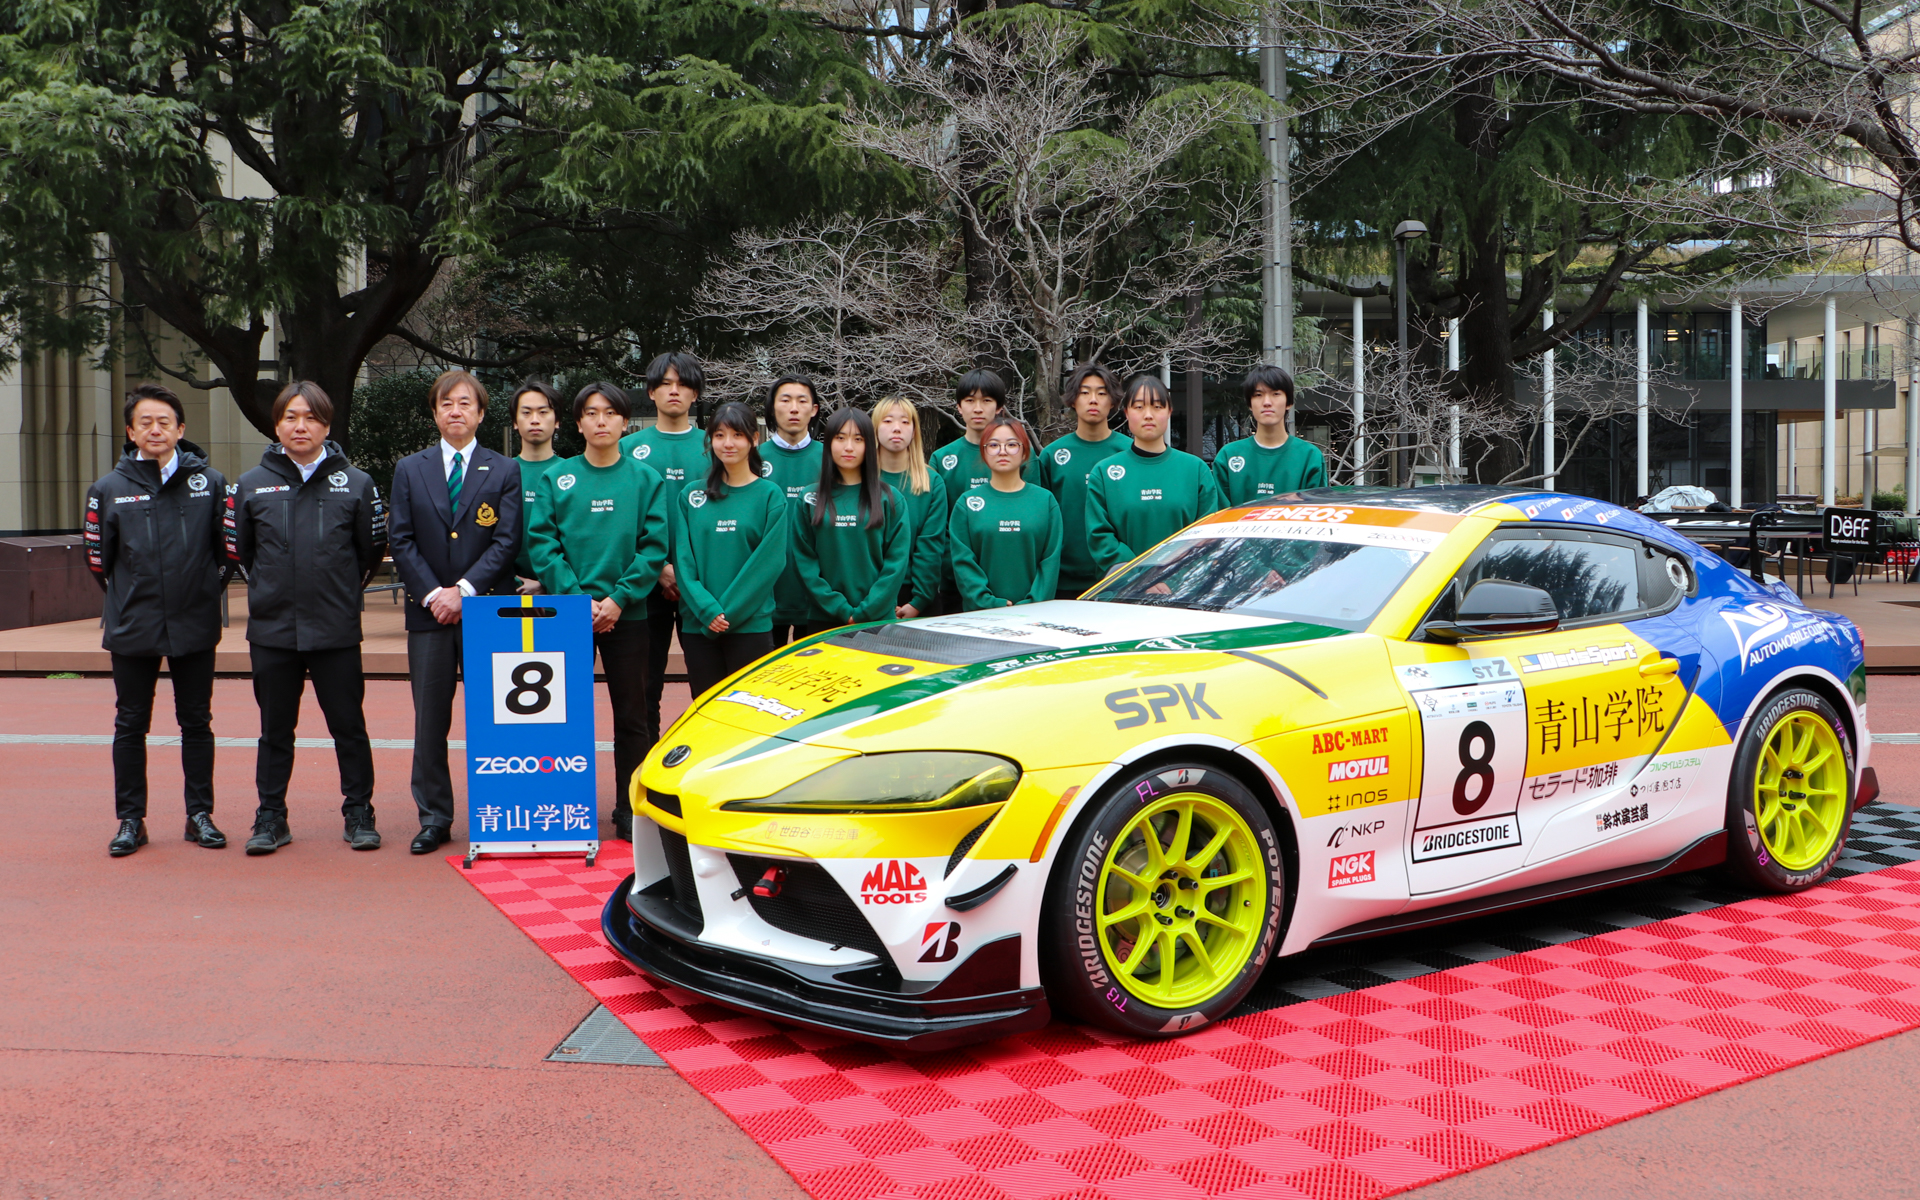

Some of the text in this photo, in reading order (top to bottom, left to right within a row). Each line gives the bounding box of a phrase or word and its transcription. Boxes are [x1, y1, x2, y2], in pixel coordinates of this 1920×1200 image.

[1258, 507, 1353, 523] ENEOS
[1536, 642, 1638, 671] WedsSport
[1750, 629, 1810, 667] AUTOMOBILE
[505, 661, 554, 715] 8
[744, 663, 863, 702] 青山学院
[1104, 682, 1223, 730] SPK
[1534, 685, 1665, 755] 青山学院
[1756, 693, 1820, 743] BRIDGESTONE
[1312, 727, 1388, 755] ABC-MART
[1329, 756, 1388, 781] MOTUL
[1452, 720, 1496, 816] 8
[1649, 757, 1701, 773] フルタイムシステム
[1135, 779, 1160, 803] FL
[1528, 761, 1619, 801] セラード珈琲
[476, 804, 591, 832] 青山学院
[1351, 820, 1385, 837] NKP
[779, 826, 860, 841] 世田谷信用金庫
[1422, 824, 1510, 853] BRIDGESTONE
[860, 860, 928, 892] MAC
[1331, 852, 1371, 878] NGK
[1785, 838, 1843, 886] POTENZA
[1331, 873, 1372, 887] SPARK PLUGS
[860, 892, 928, 905] TOOLS
[1075, 830, 1109, 989] BRIDGESTONE
[1253, 828, 1282, 967] POTENZA
